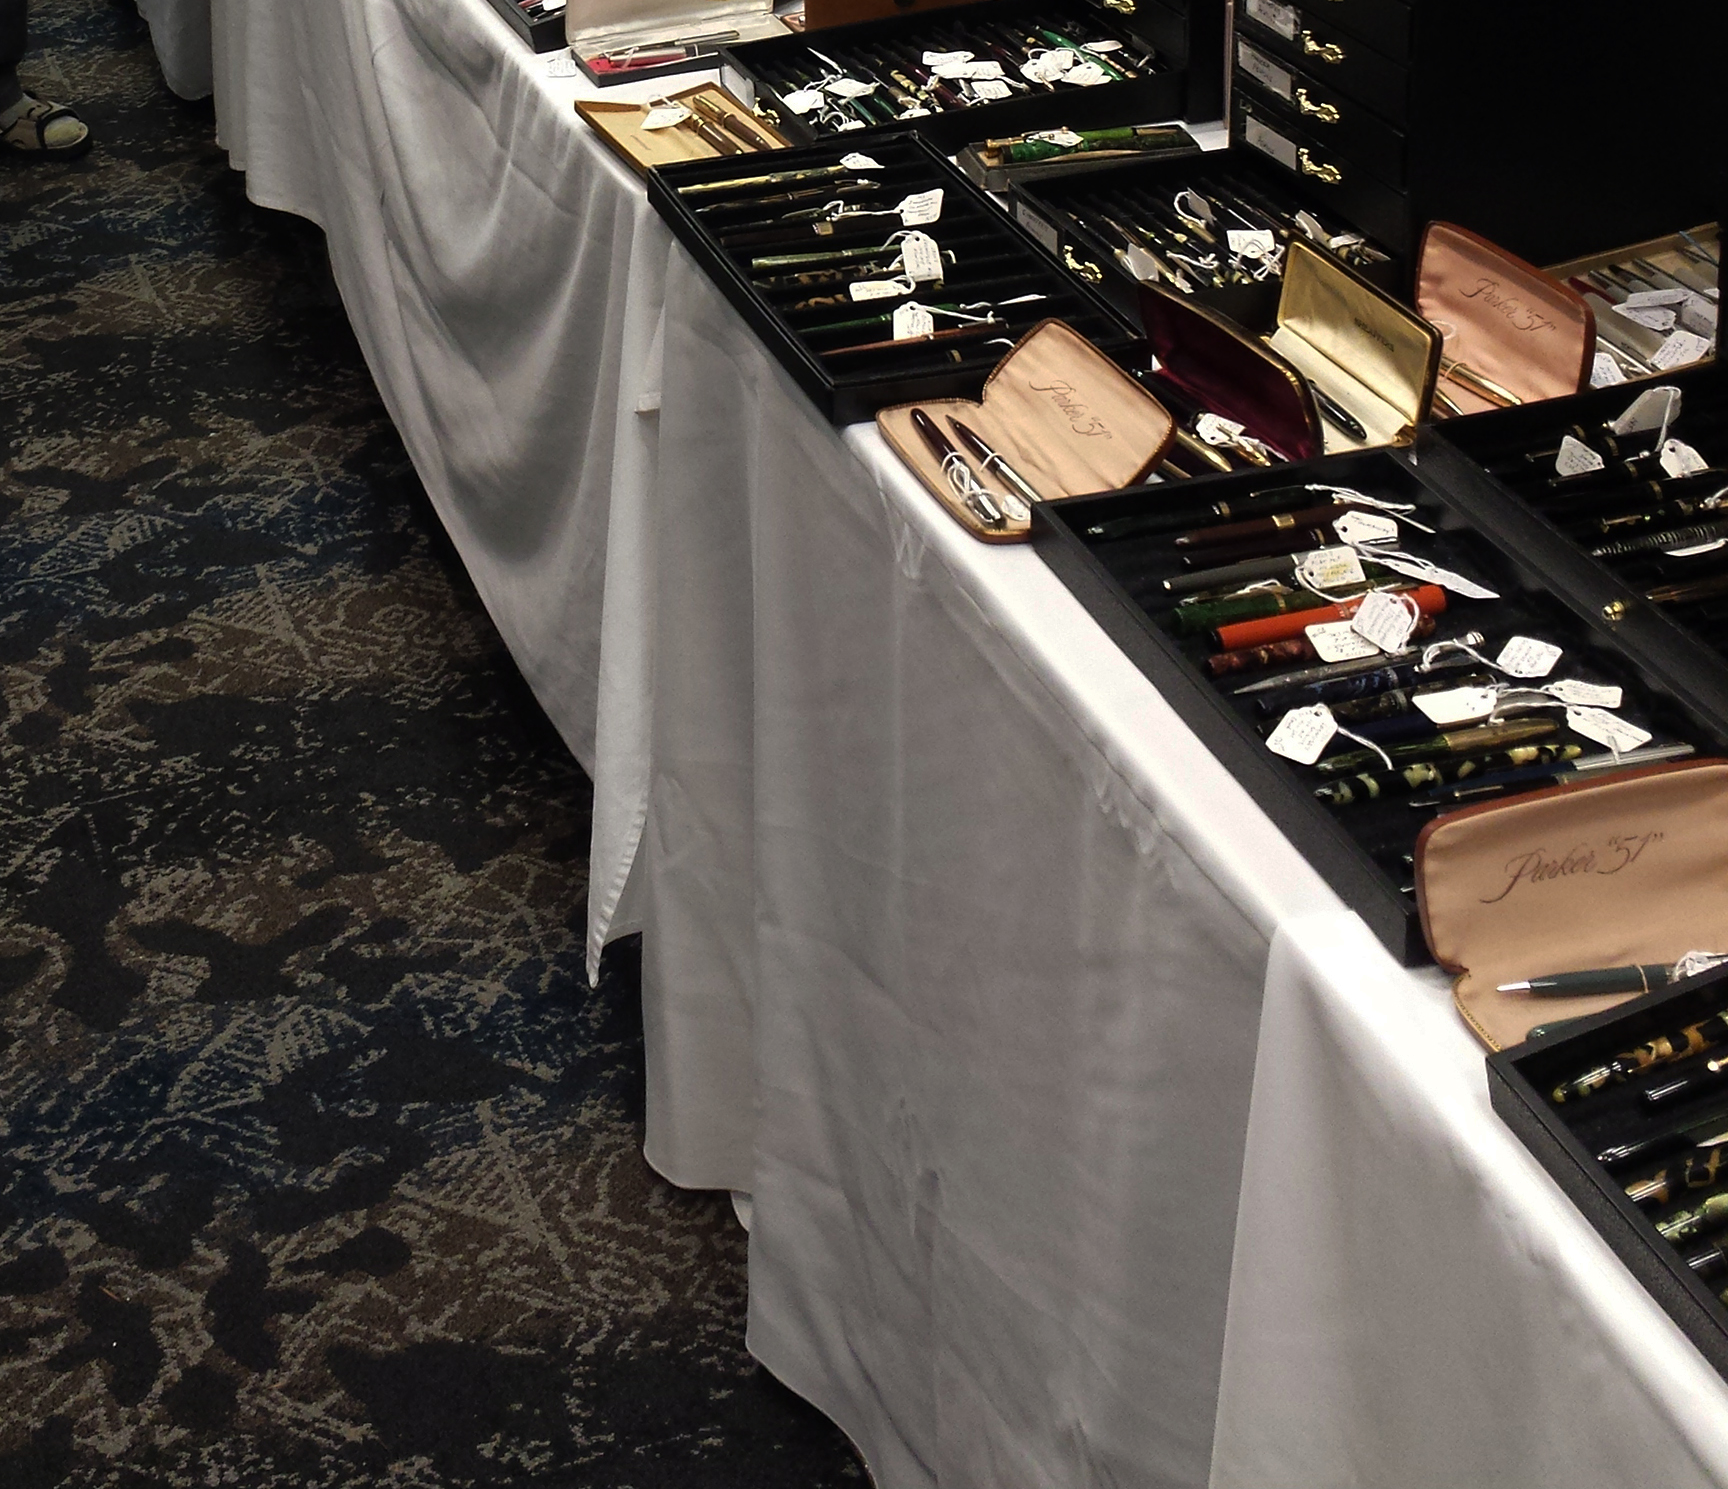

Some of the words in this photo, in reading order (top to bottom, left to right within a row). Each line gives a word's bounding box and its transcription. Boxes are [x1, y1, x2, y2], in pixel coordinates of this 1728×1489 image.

[1458, 277, 1519, 319] Parker
[1028, 379, 1089, 423] Parker
[1479, 845, 1597, 905] Parker
